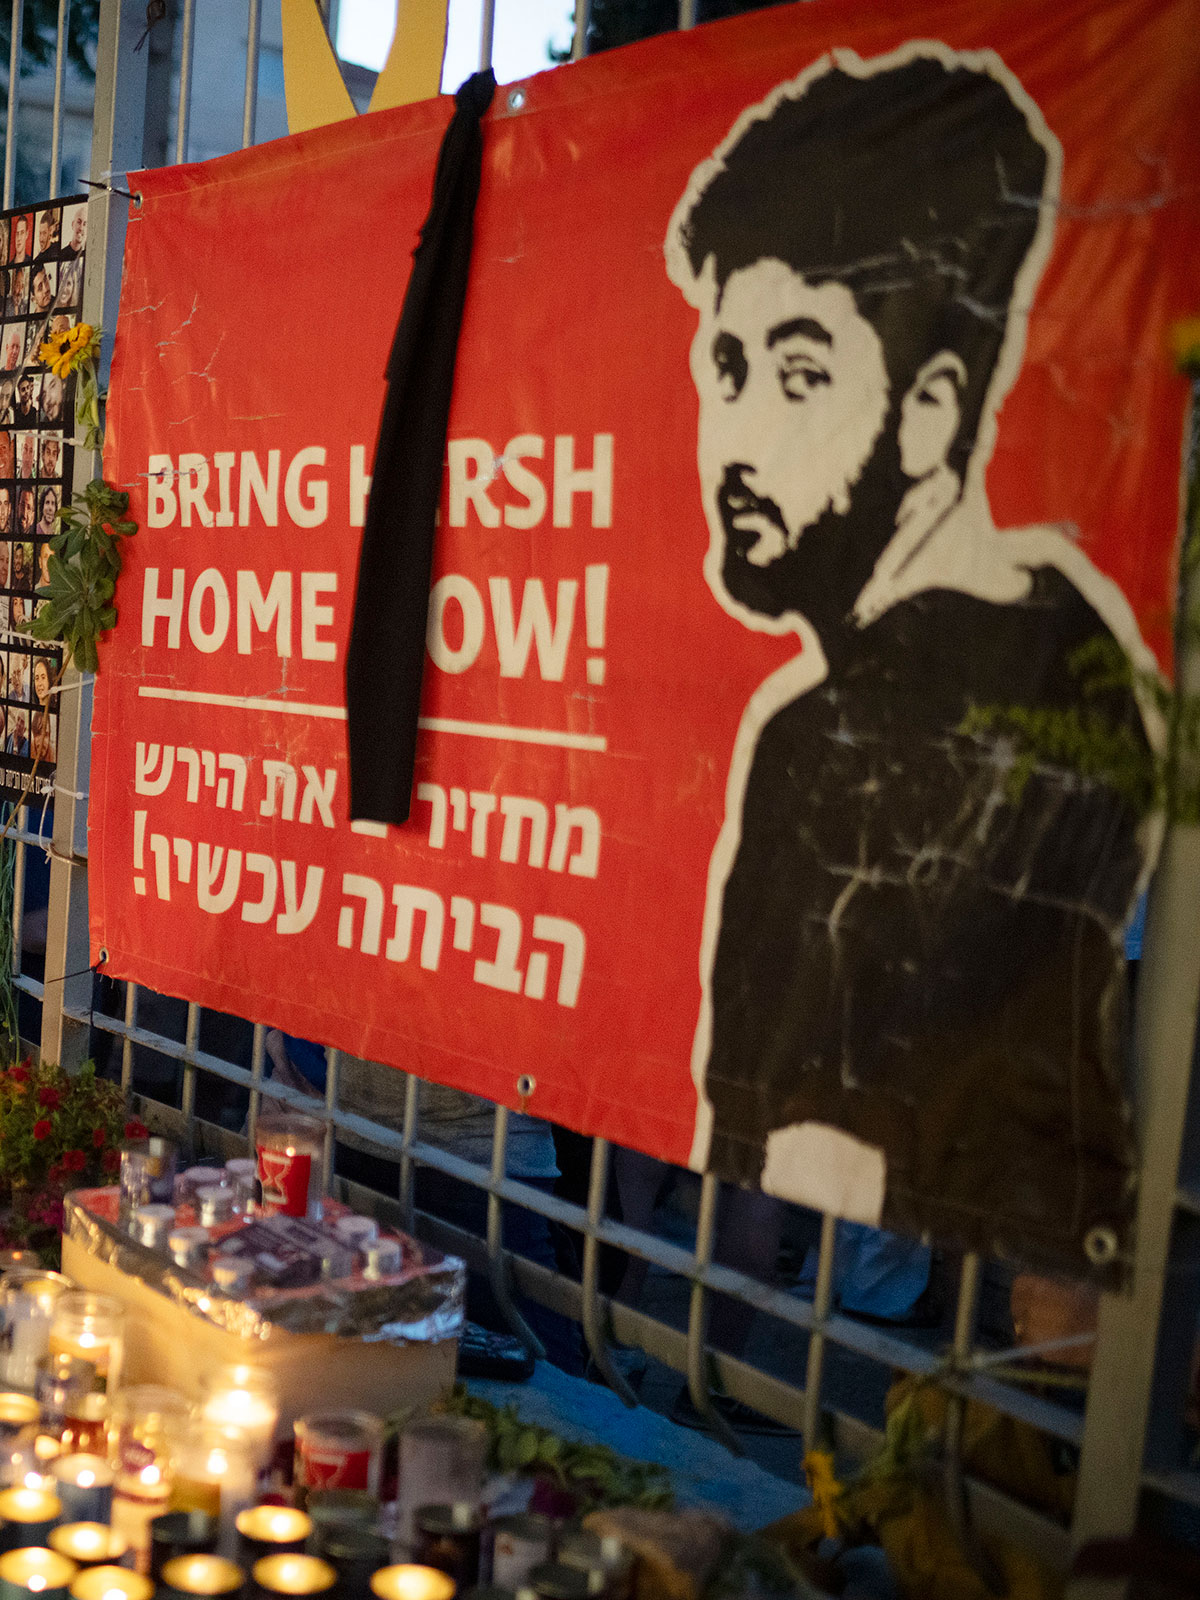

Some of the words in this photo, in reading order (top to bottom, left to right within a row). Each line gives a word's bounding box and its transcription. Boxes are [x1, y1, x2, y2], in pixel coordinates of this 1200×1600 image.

[146, 446, 329, 529] BRING
[349, 432, 615, 530] RSH
[141, 567, 338, 663] HOME
[427, 563, 609, 686] OW!
[134, 741, 248, 811] הירש
[260, 749, 338, 828] את
[132, 810, 325, 935] עכשיו!
[350, 782, 603, 879] מחזיר
[337, 872, 587, 1008] הביתה
